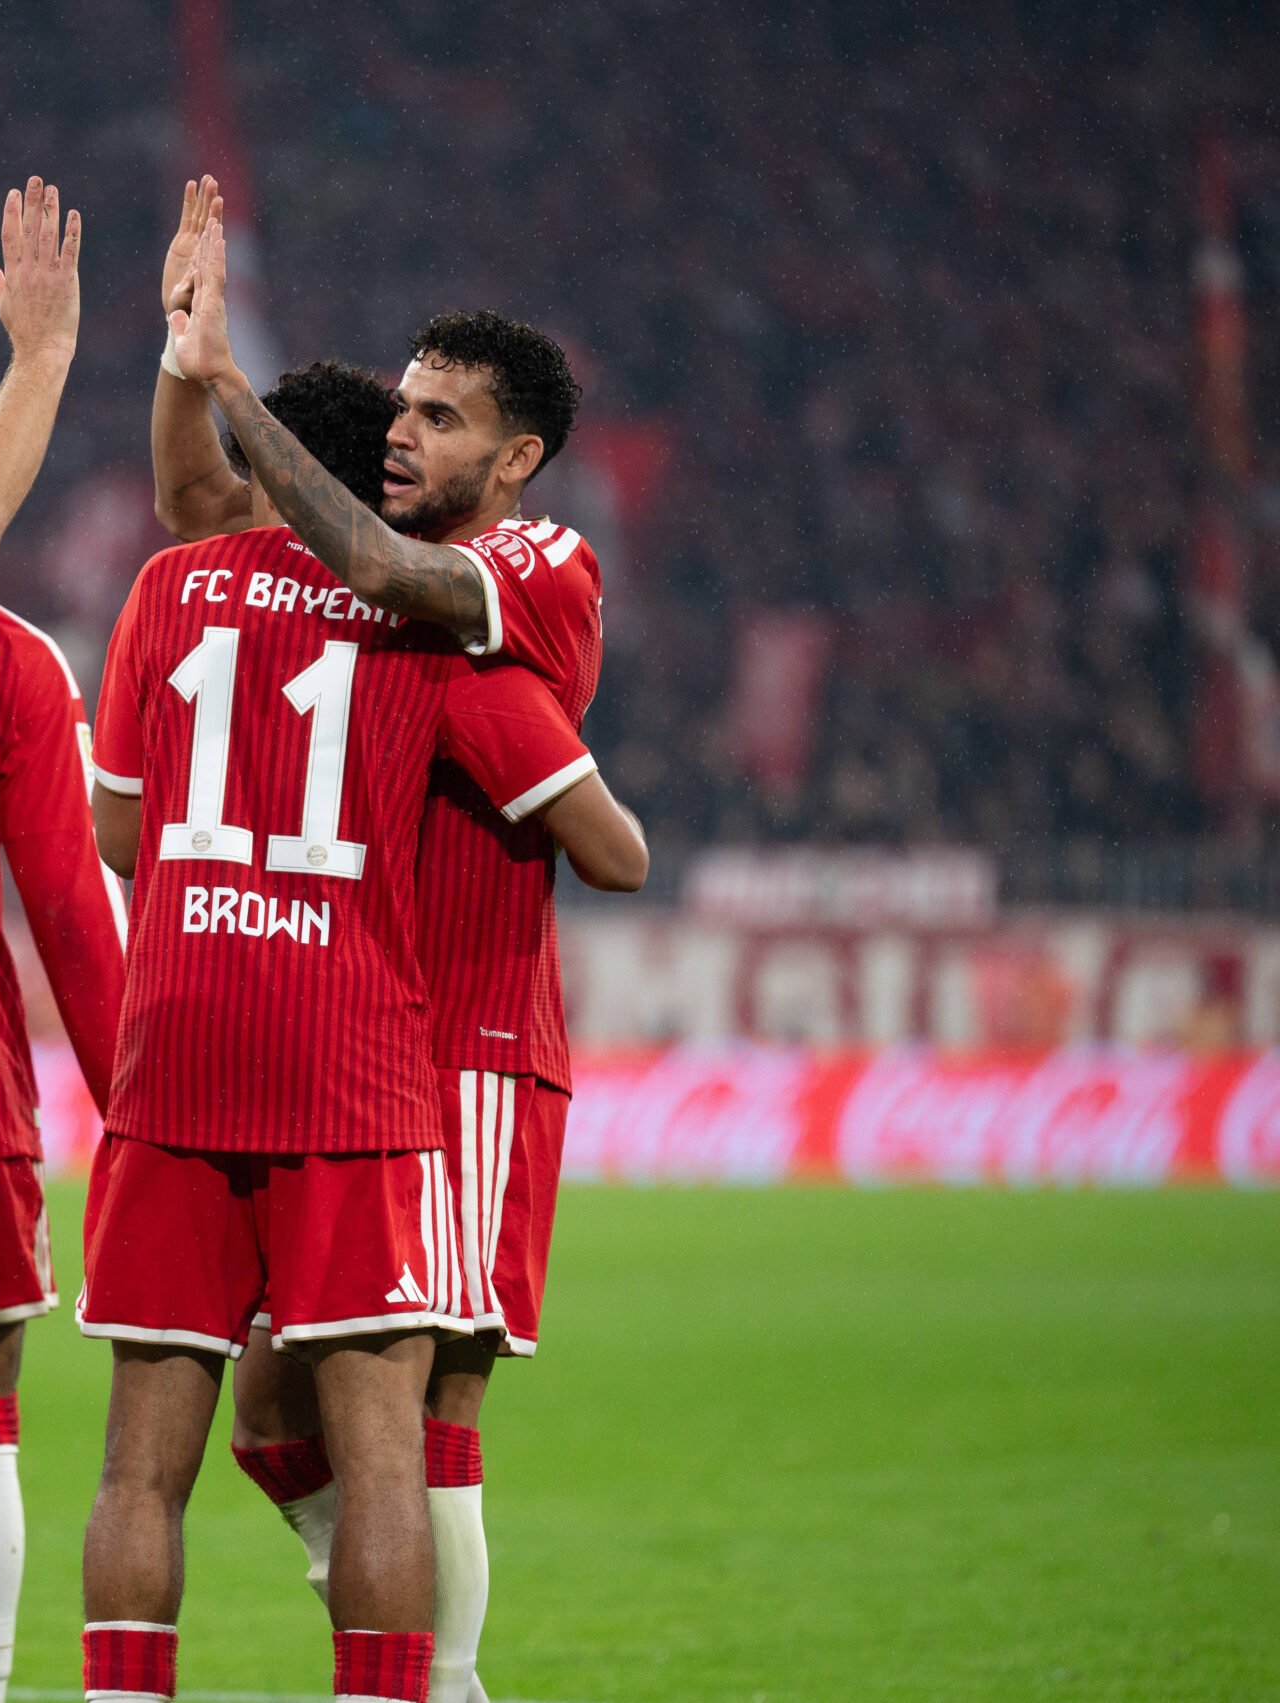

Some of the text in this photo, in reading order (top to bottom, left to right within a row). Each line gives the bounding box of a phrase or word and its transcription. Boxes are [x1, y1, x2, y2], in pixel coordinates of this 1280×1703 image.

[180, 569, 234, 605] FC
[158, 625, 368, 881] 11
[181, 885, 331, 946] BROWN
